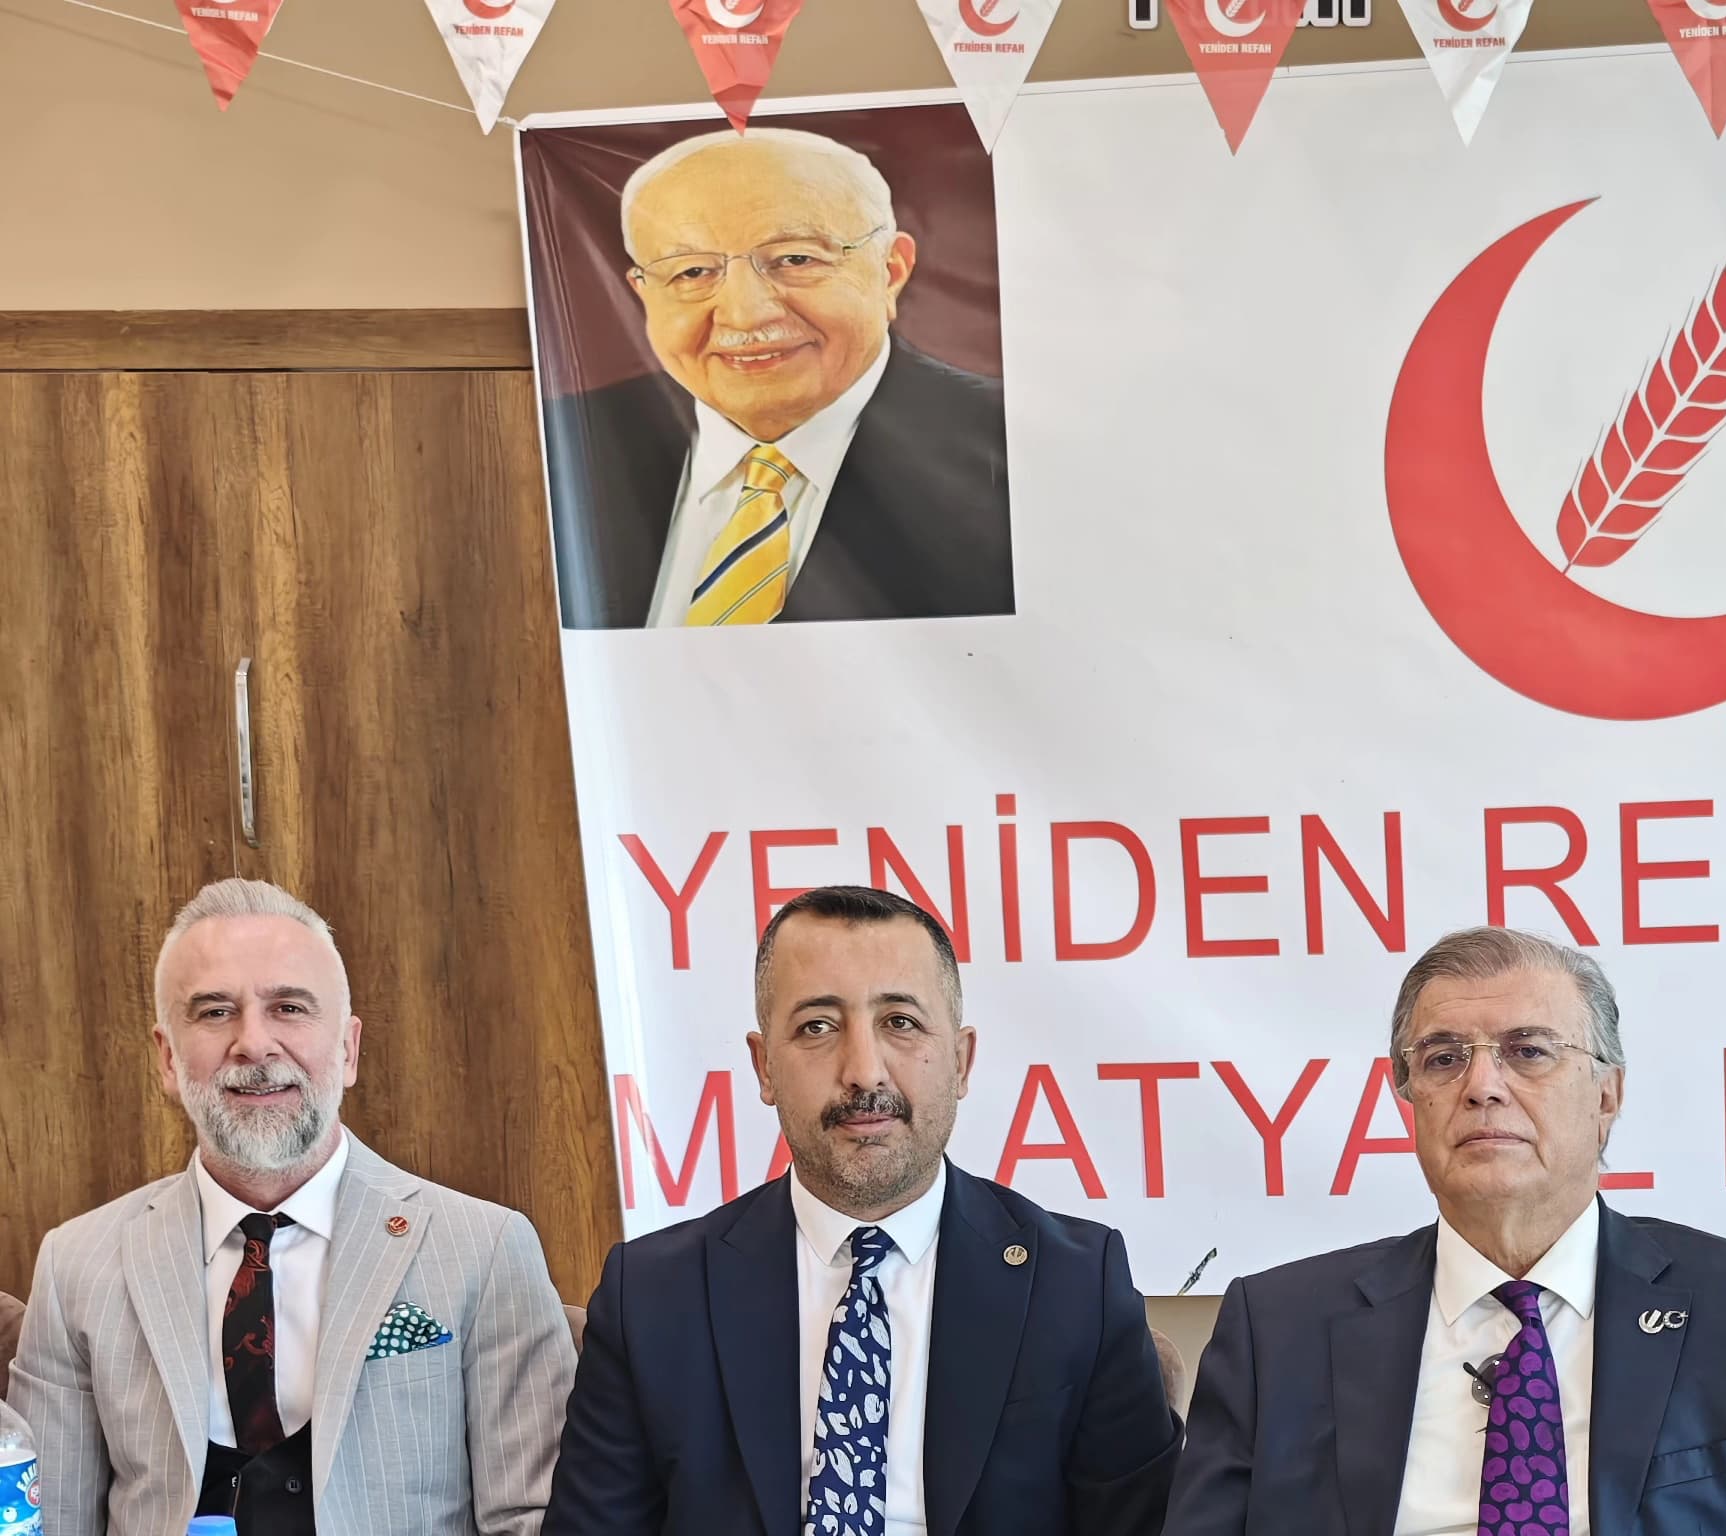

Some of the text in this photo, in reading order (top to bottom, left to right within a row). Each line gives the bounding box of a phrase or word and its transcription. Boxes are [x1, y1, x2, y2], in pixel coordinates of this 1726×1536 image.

[1475, 37, 1505, 47] REFAH
[995, 43, 1024, 53] REFAH
[1241, 43, 1271, 54] REFAH
[617, 794, 1406, 970] YENİDEN
[614, 1057, 1416, 1210] MATYA
